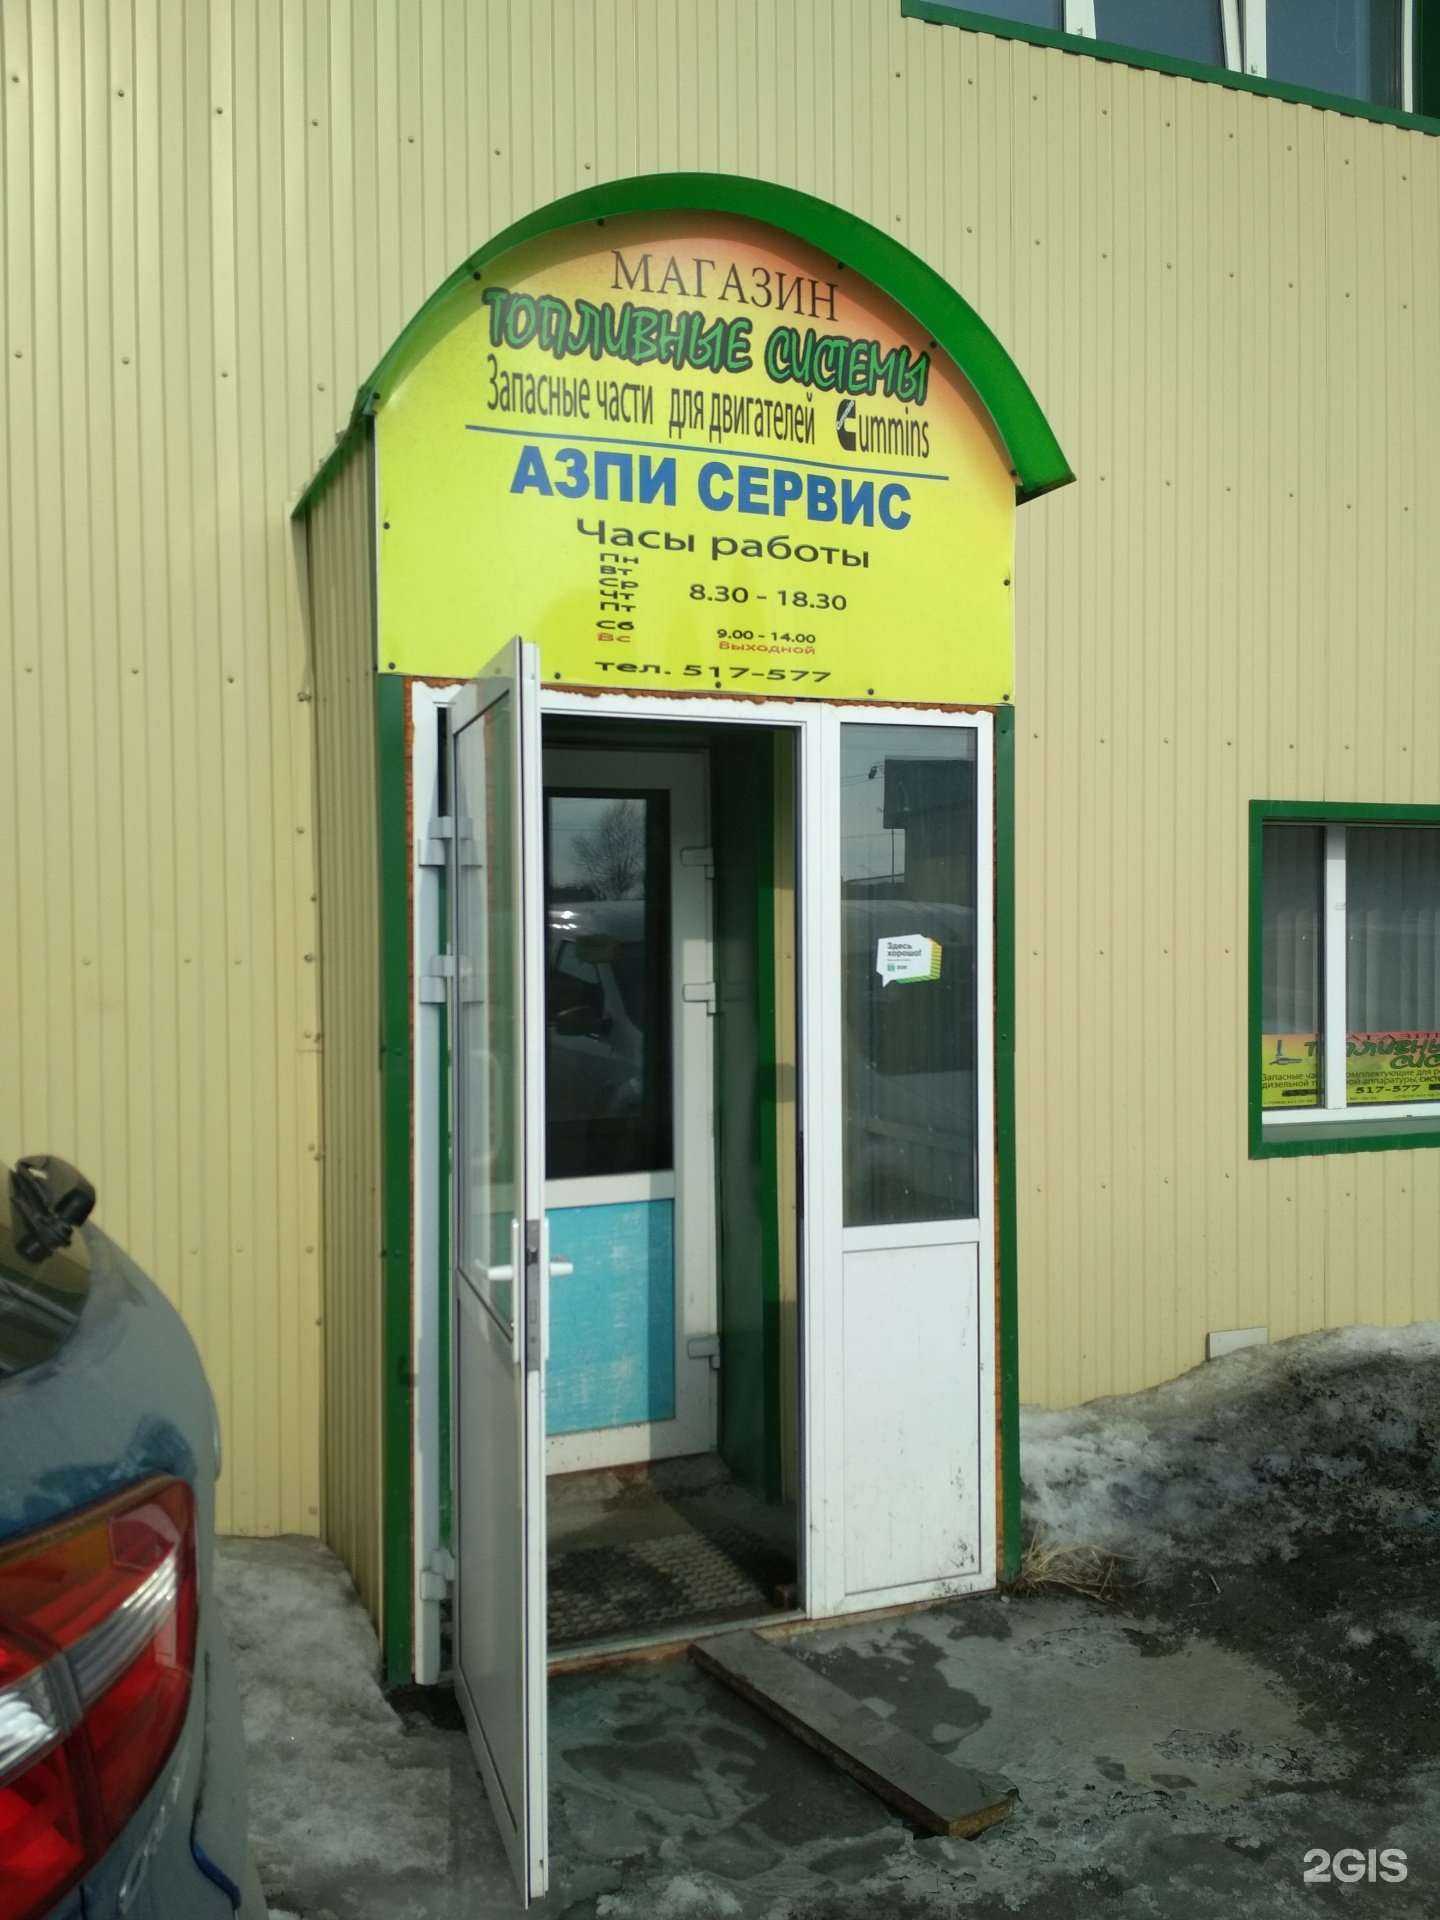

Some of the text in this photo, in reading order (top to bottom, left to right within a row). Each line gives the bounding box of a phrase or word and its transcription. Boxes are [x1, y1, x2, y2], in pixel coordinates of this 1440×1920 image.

[610, 249, 839, 322] МАГАЗИН
[482, 287, 929, 406] ТОПЛИВНЫЕ СИСТЕМЫ
[487, 353, 590, 419] Запасные
[597, 378, 653, 424] части
[669, 387, 704, 439] для
[709, 392, 815, 444] двигателей
[836, 399, 929, 457] Cummins
[510, 445, 911, 530] АЗПИ СЕРВИС
[577, 518, 869, 568] Часы работы
[600, 553, 639, 564] Пн
[600, 565, 633, 576] Вт
[599, 577, 639, 589] Ср
[600, 589, 634, 600] Чт
[600, 601, 636, 612] Пт
[689, 583, 749, 603] 8.30
[777, 590, 847, 611] 18.30
[596, 620, 634, 631] Сб
[717, 629, 754, 640] 9.00
[771, 632, 816, 643] 14.00
[597, 632, 816, 655] Вс Выходной
[595, 661, 831, 683] тел. 517-577
[1355, 1084, 1421, 1094] 517-577
